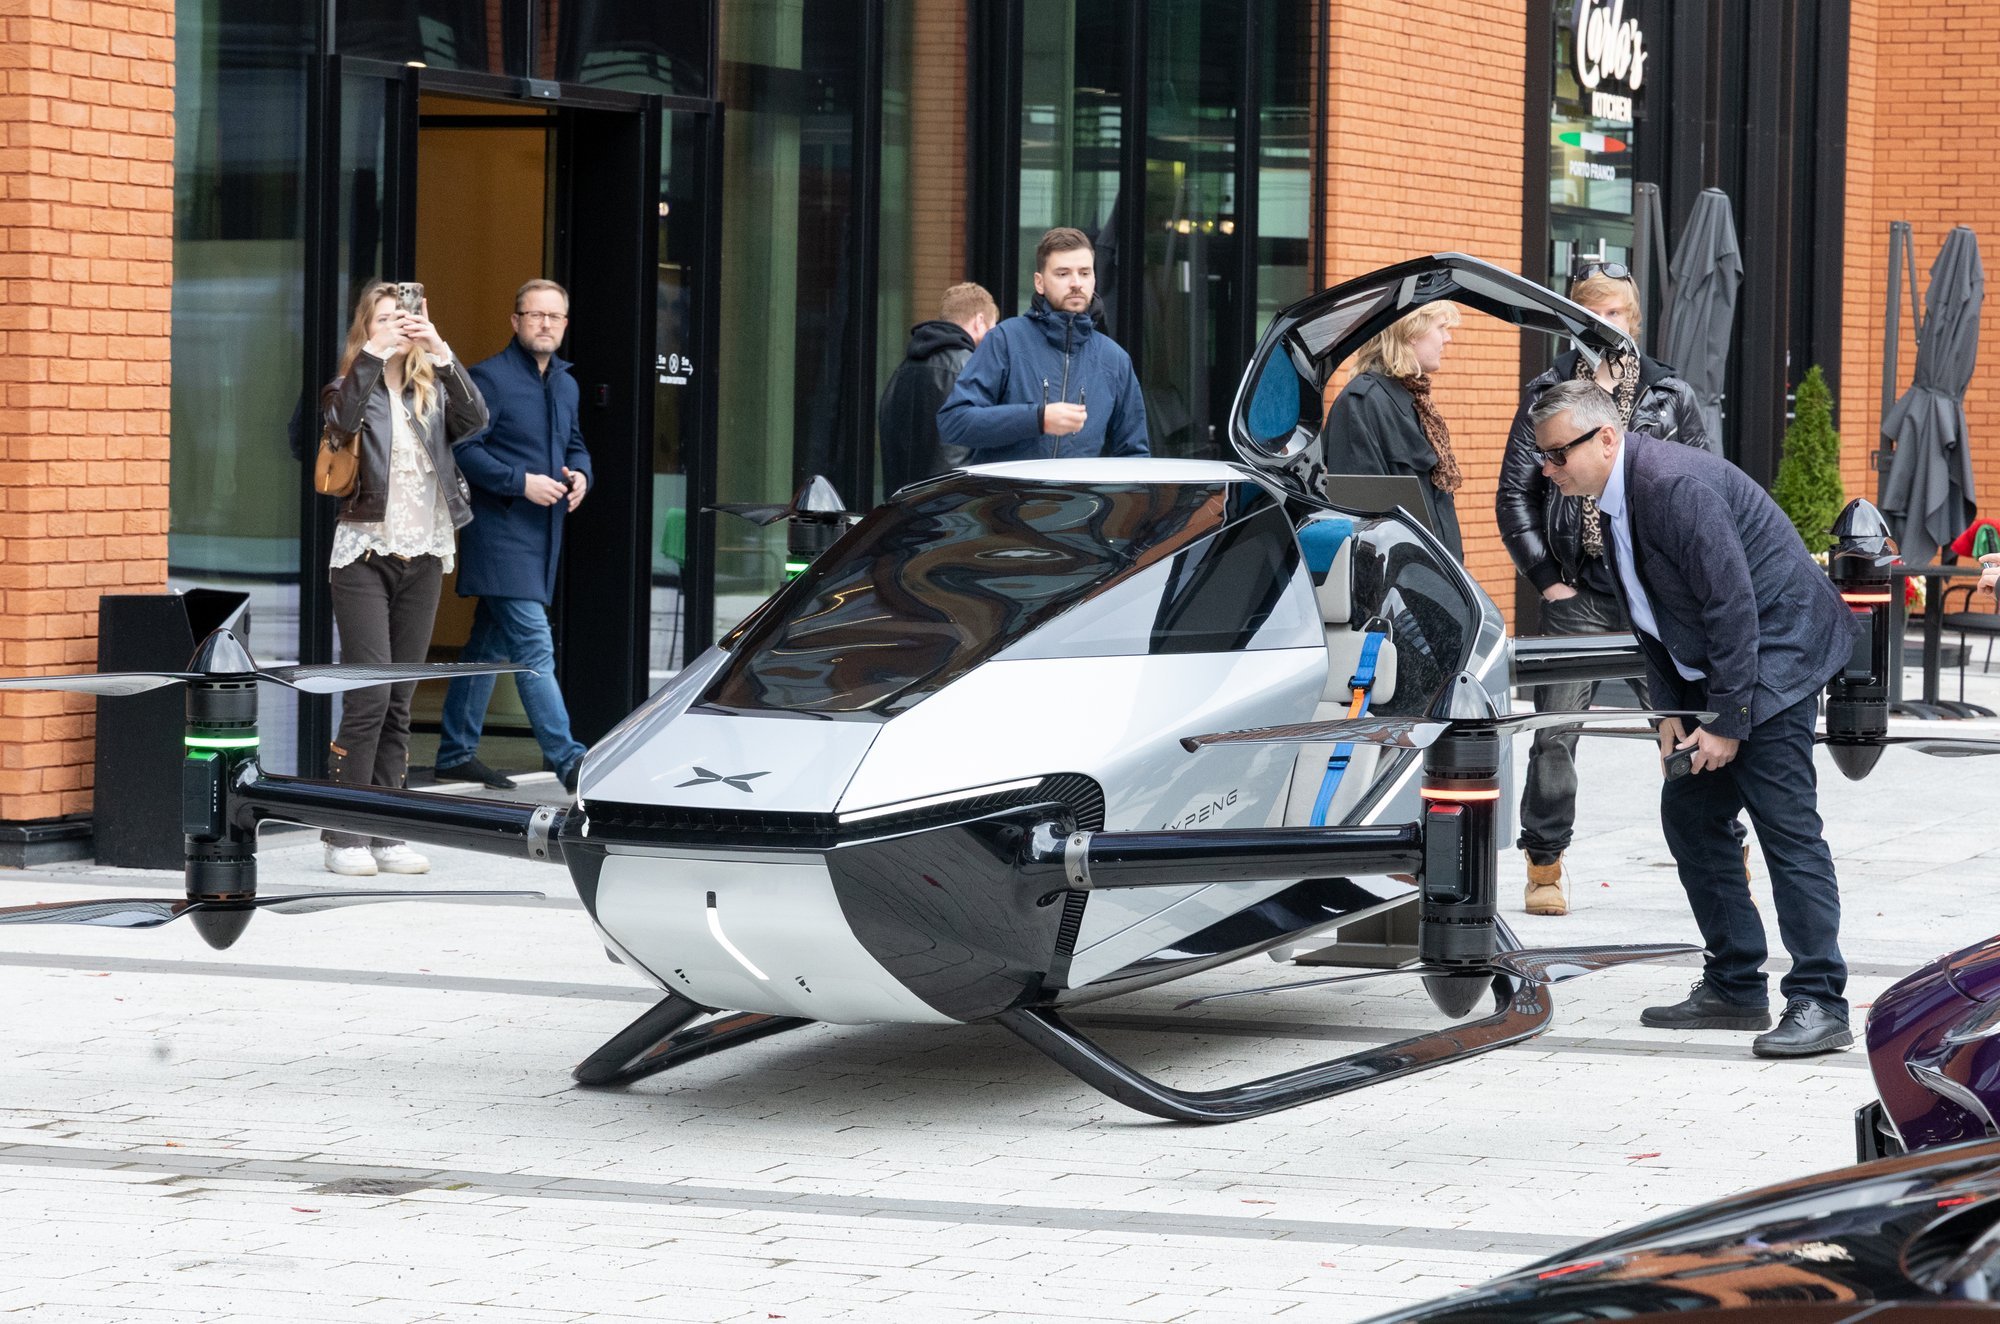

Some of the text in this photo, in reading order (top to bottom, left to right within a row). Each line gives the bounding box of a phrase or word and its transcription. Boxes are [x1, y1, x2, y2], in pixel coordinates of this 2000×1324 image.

[1576, 0, 1648, 91] Carlo's
[1592, 91, 1633, 122] KITCHEN
[1569, 160, 1616, 181] PORTO FRANCO
